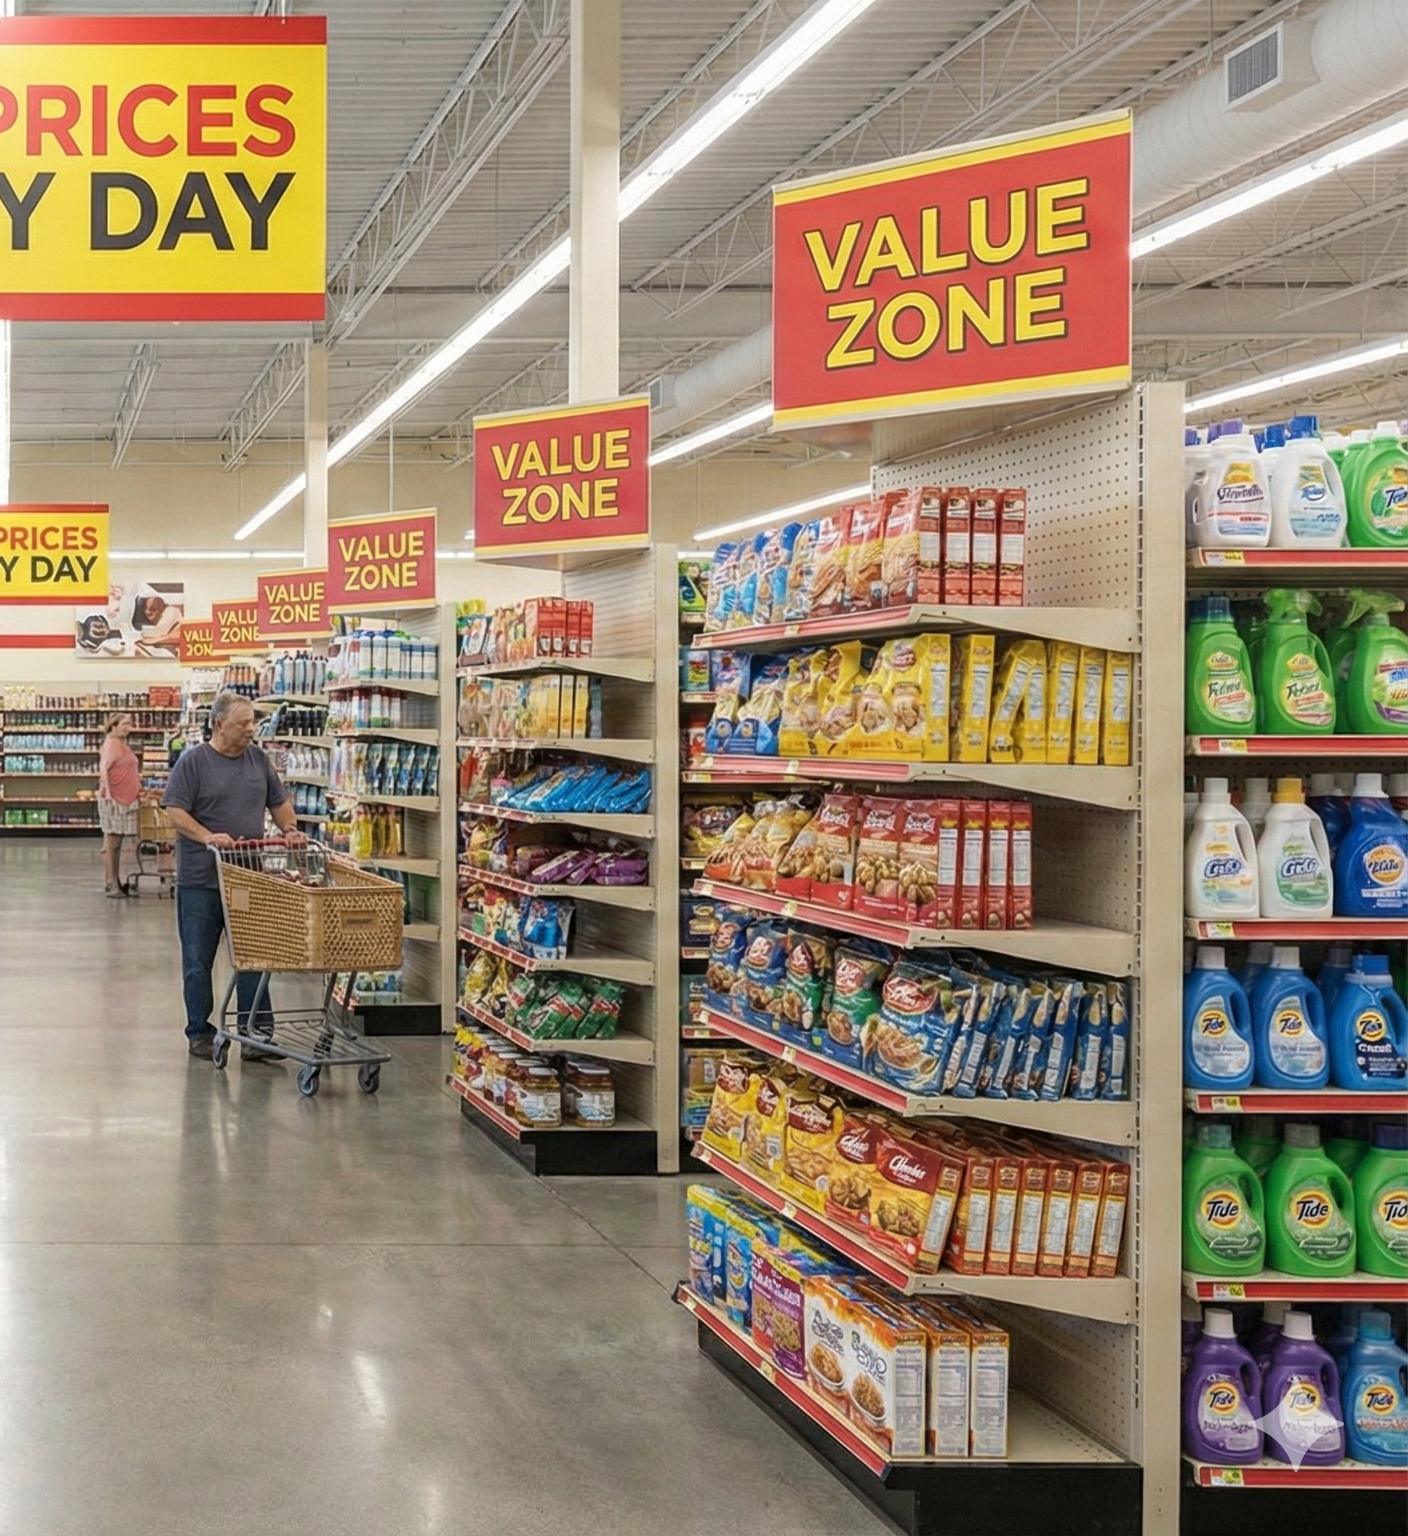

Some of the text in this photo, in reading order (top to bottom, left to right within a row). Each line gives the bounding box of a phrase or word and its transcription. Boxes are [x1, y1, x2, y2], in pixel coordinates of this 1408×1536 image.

[90, 170, 296, 251] DAY
[803, 176, 1090, 292] VALUE
[824, 266, 1068, 371] ZONE
[492, 428, 632, 481] VALUE
[501, 478, 620, 527] ZONE
[338, 530, 424, 562] VALUE
[30, 556, 98, 583] DAY
[344, 561, 418, 591] ZONE
[264, 582, 325, 604] VALUE
[217, 609, 257, 625] VALU
[269, 604, 320, 624] ZONE
[183, 629, 213, 641] VALU
[186, 643, 212, 656] ZON
[1384, 1201, 1408, 1221] Tid
